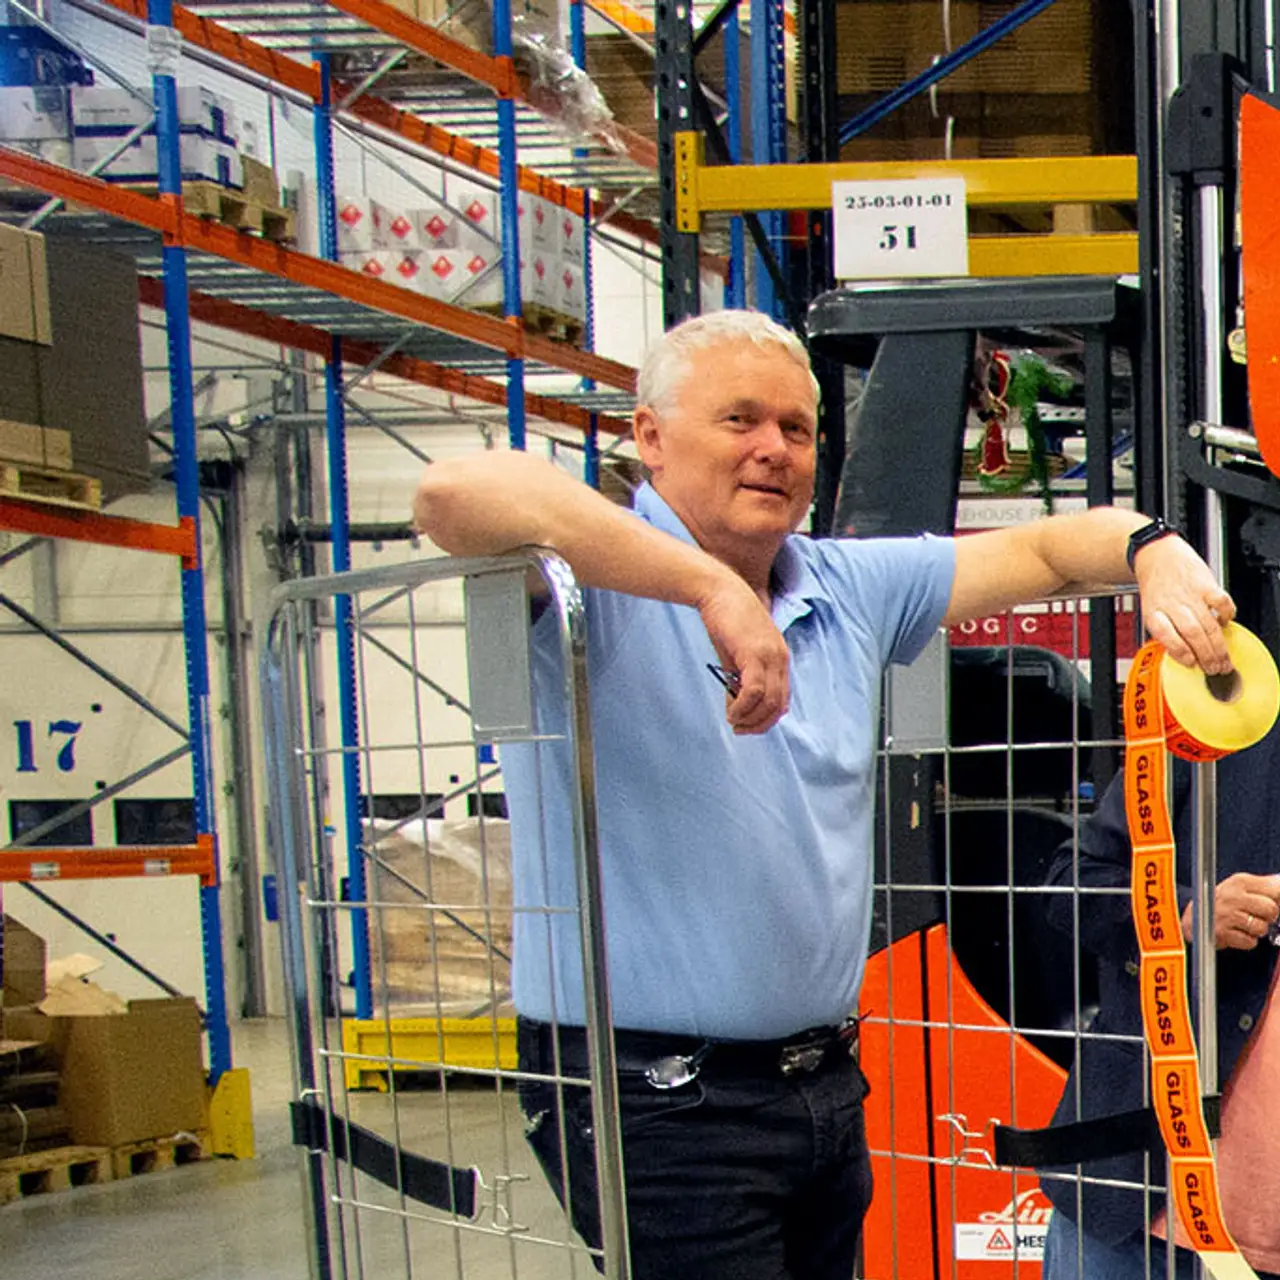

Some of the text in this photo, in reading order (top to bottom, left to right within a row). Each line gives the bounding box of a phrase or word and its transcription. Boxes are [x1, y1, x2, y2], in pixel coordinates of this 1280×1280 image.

[845, 194, 951, 209] 25-03-01-01
[879, 225, 917, 250] 51
[12, 719, 83, 773] 17
[1135, 755, 1155, 836] GLASS
[1144, 861, 1164, 941] GLASS
[1154, 966, 1175, 1047] GLASS
[1166, 1071, 1192, 1149] GLASS
[1185, 1172, 1214, 1246] GLASS
